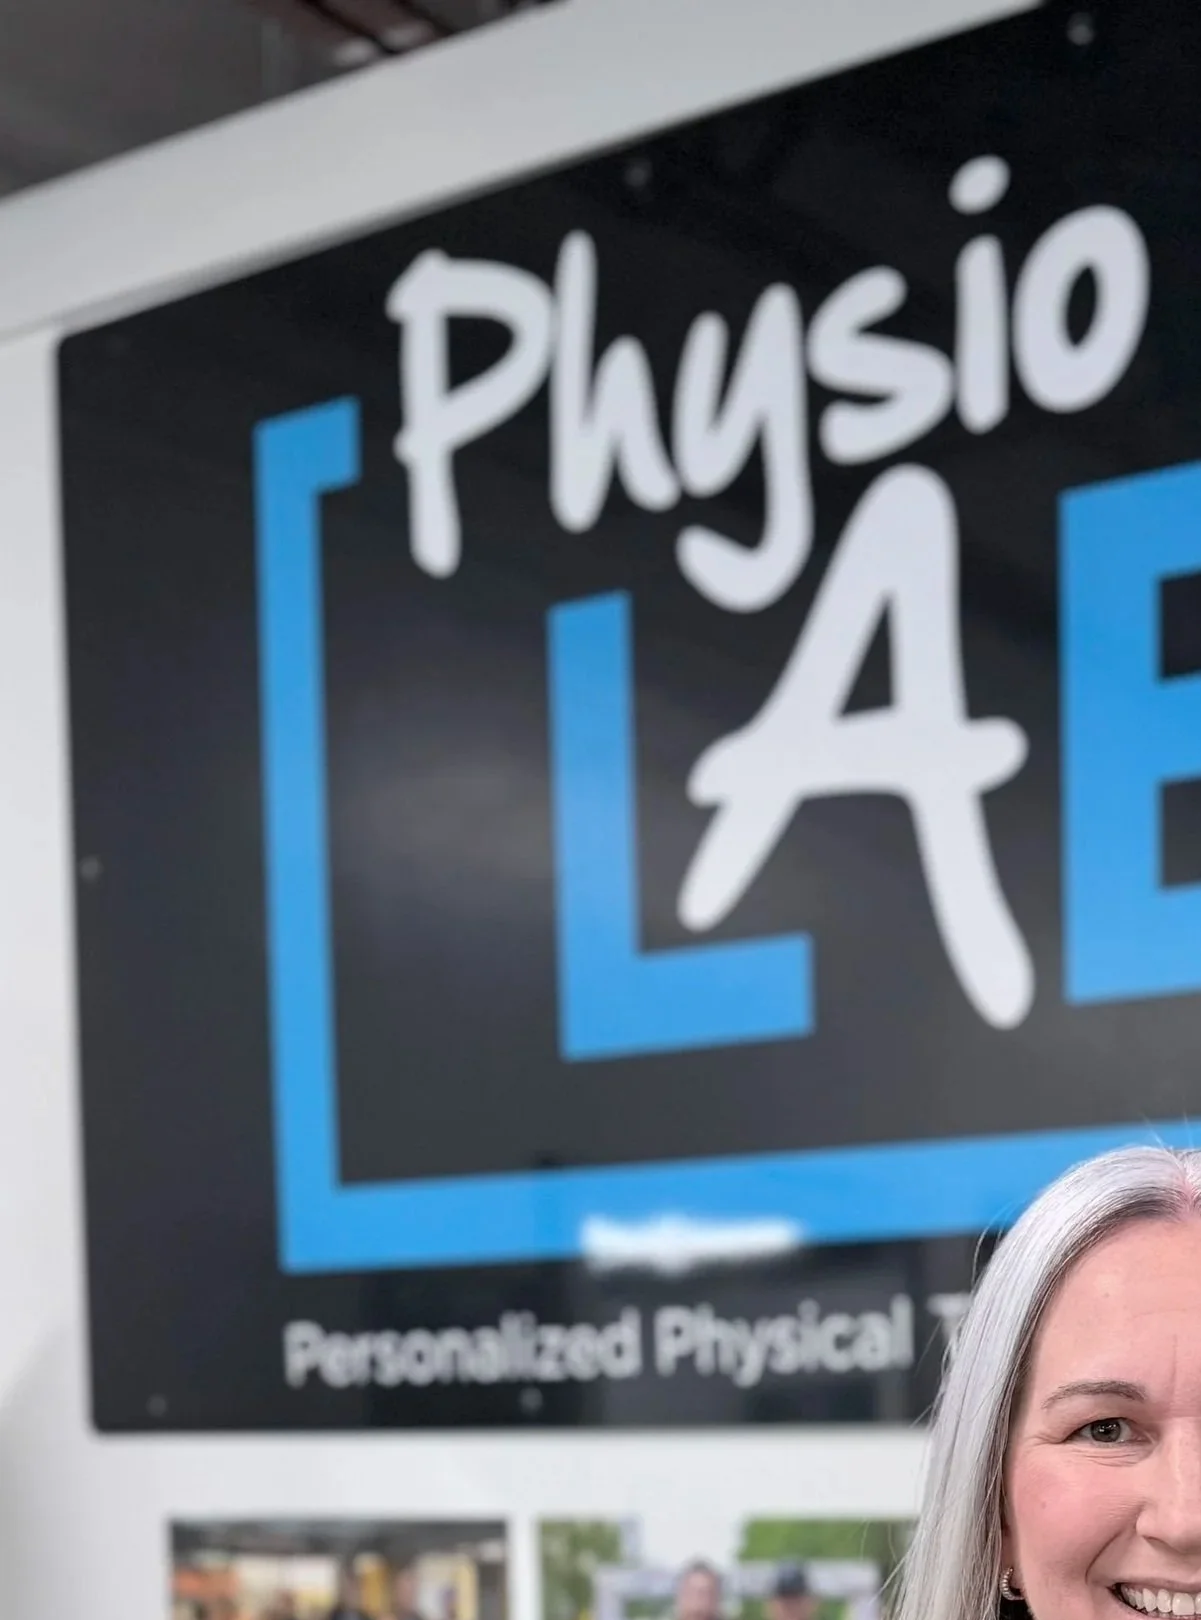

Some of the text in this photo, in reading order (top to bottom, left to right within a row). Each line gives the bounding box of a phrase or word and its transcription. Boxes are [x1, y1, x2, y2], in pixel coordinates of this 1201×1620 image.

[386, 155, 1149, 612] Physio
[283, 1306, 641, 1388] Personalized
[653, 1294, 915, 1387] Physical
